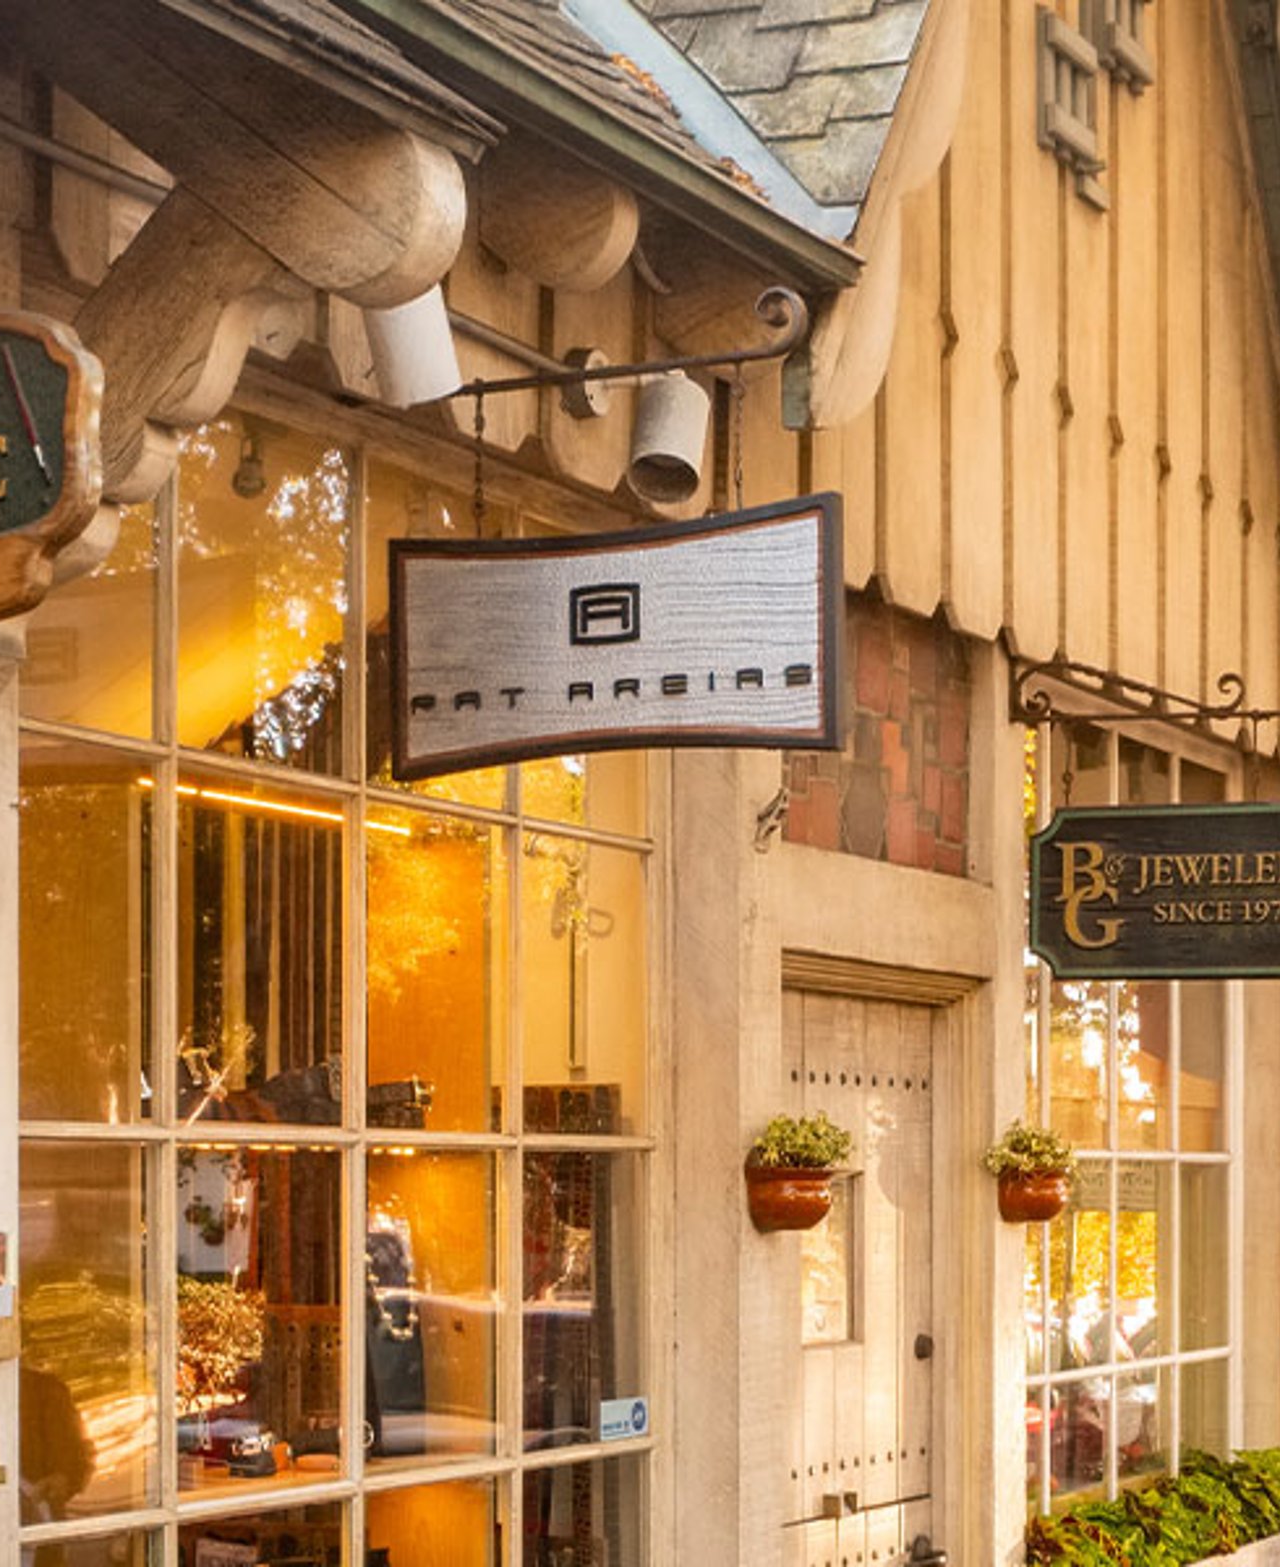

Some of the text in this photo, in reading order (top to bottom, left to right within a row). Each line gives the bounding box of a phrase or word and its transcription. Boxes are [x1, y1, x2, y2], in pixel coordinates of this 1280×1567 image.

[411, 663, 812, 715] PAT AREIAS
[1153, 900, 1232, 923] SINCE
